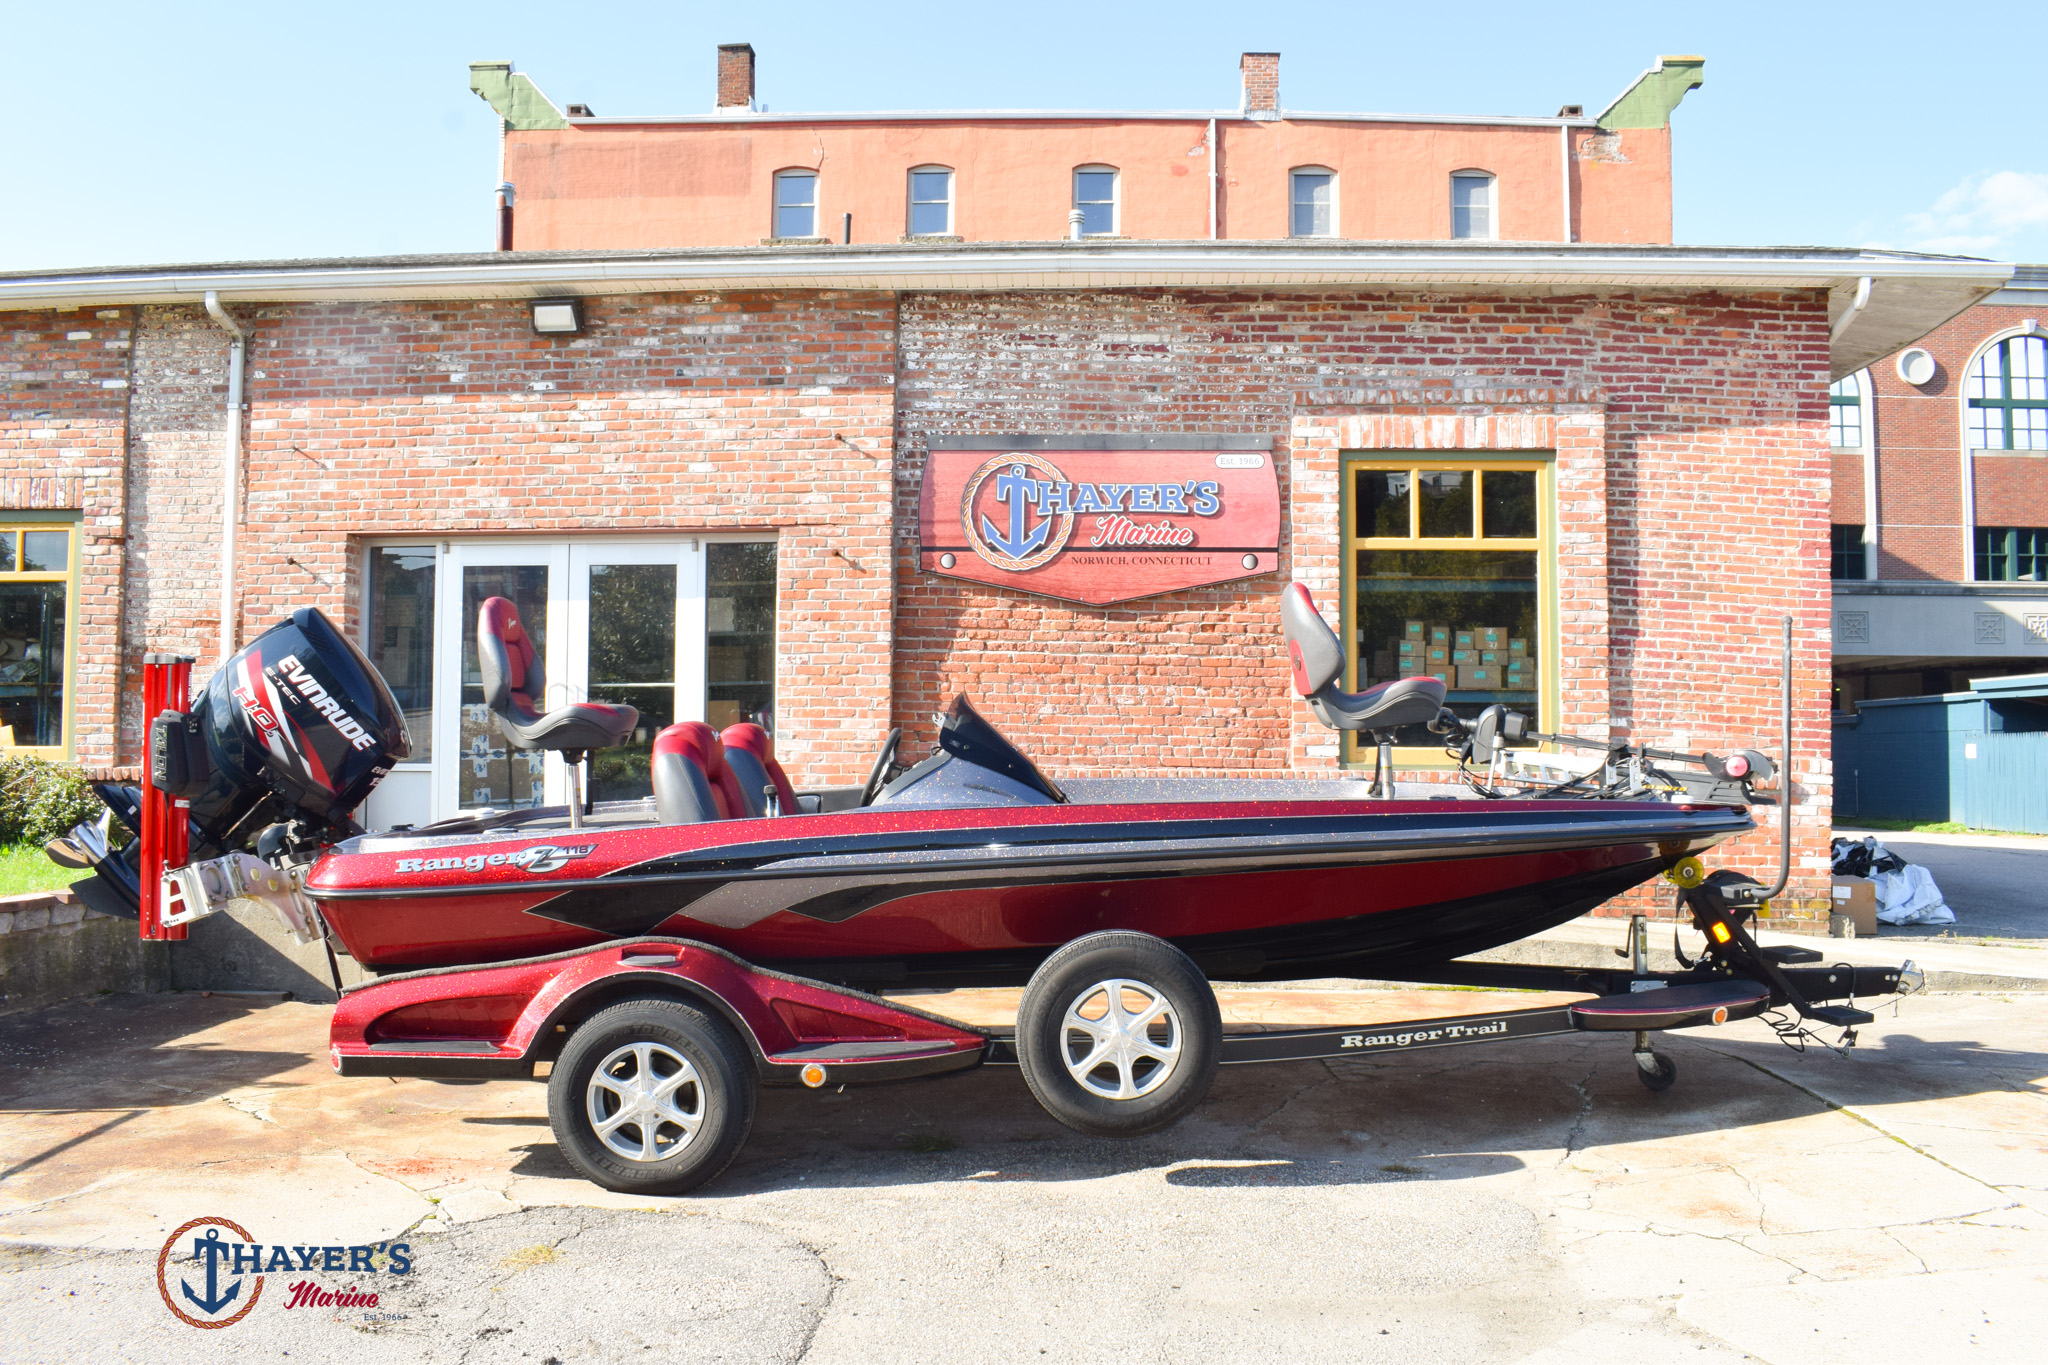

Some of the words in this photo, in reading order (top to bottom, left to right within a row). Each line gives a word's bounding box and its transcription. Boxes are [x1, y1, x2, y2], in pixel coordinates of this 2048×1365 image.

[1220, 457, 1236, 465] Est.
[1239, 457, 1260, 465] 1966
[1091, 516, 1195, 548] Marine
[1131, 556, 1213, 566] CONNECTICUT
[265, 667, 302, 706] E-TEC
[277, 654, 377, 753] EVINRUDE
[154, 724, 167, 782] TALON
[395, 850, 526, 874] Ranger
[1340, 1029, 1443, 1048] Ranger
[1445, 1021, 1508, 1038] Trail
